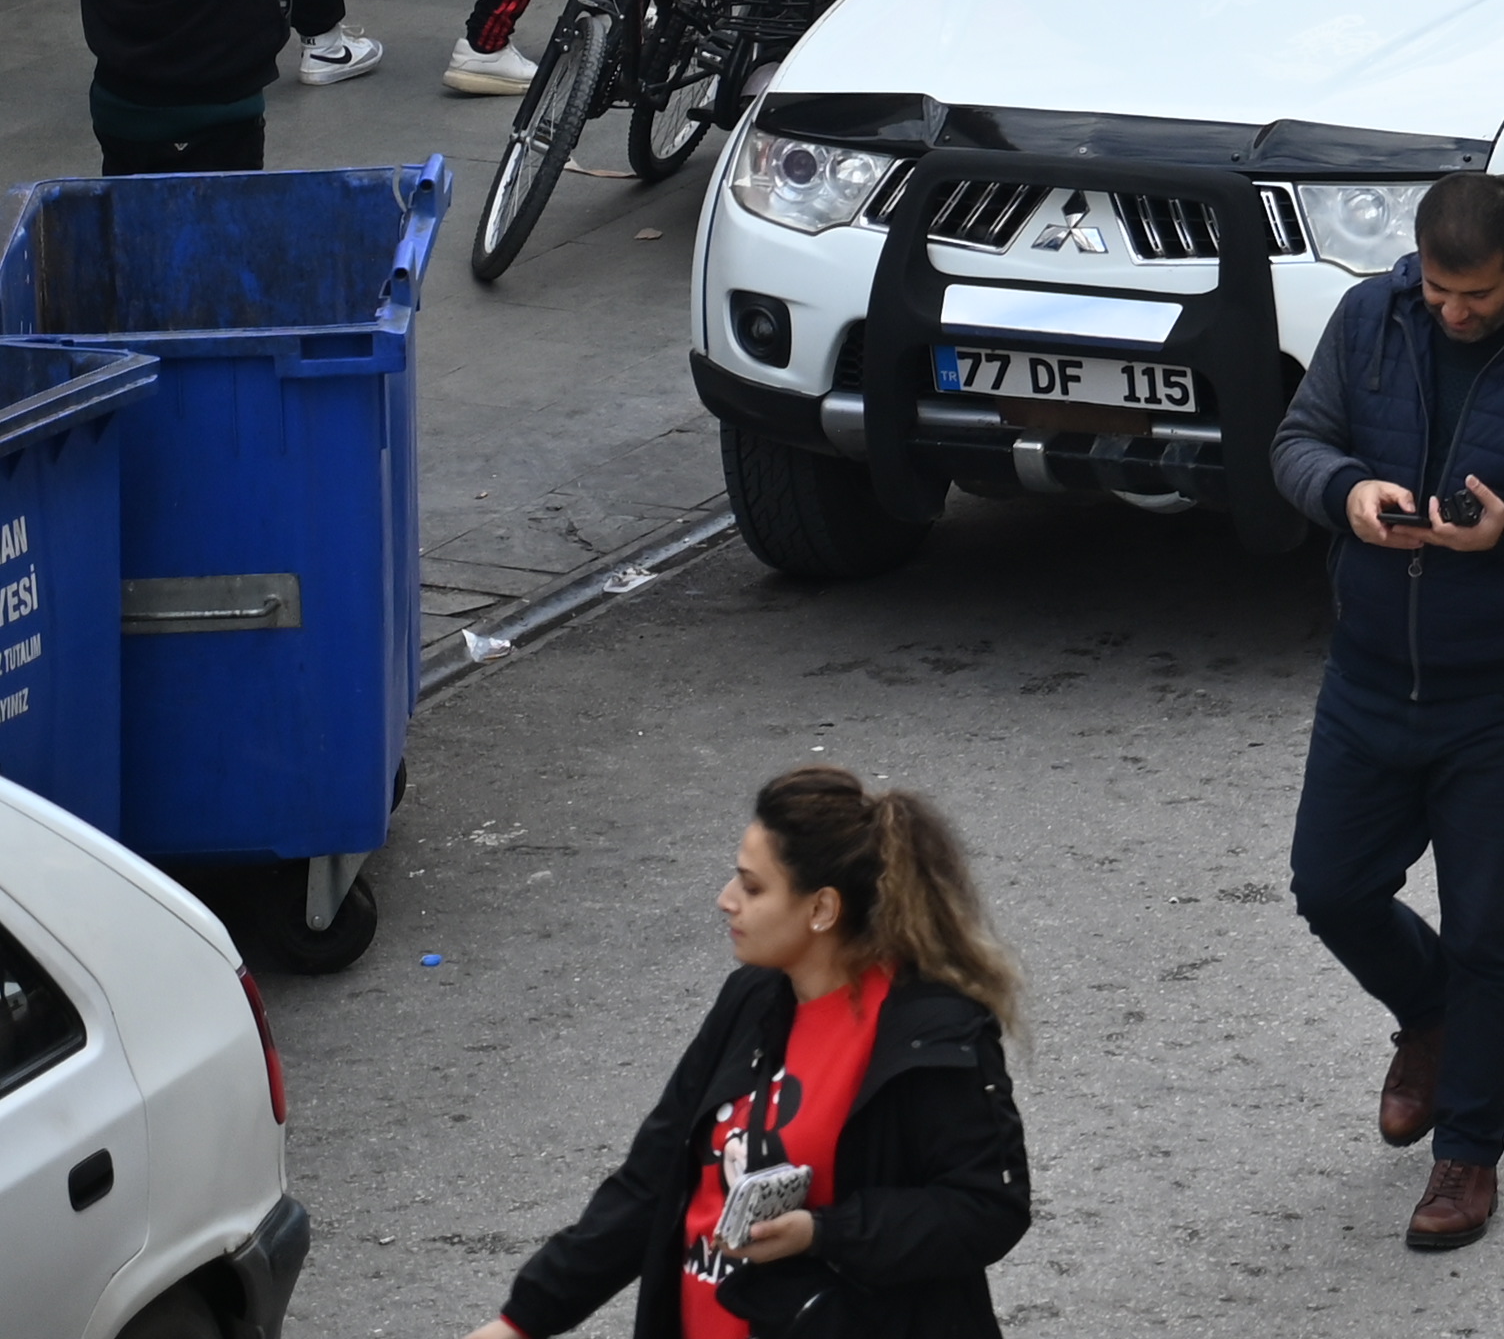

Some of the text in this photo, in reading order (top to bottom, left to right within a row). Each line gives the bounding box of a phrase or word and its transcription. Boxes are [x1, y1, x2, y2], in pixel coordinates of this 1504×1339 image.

[940, 369, 957, 384] TR
[957, 349, 1191, 408] 77 DF 115
